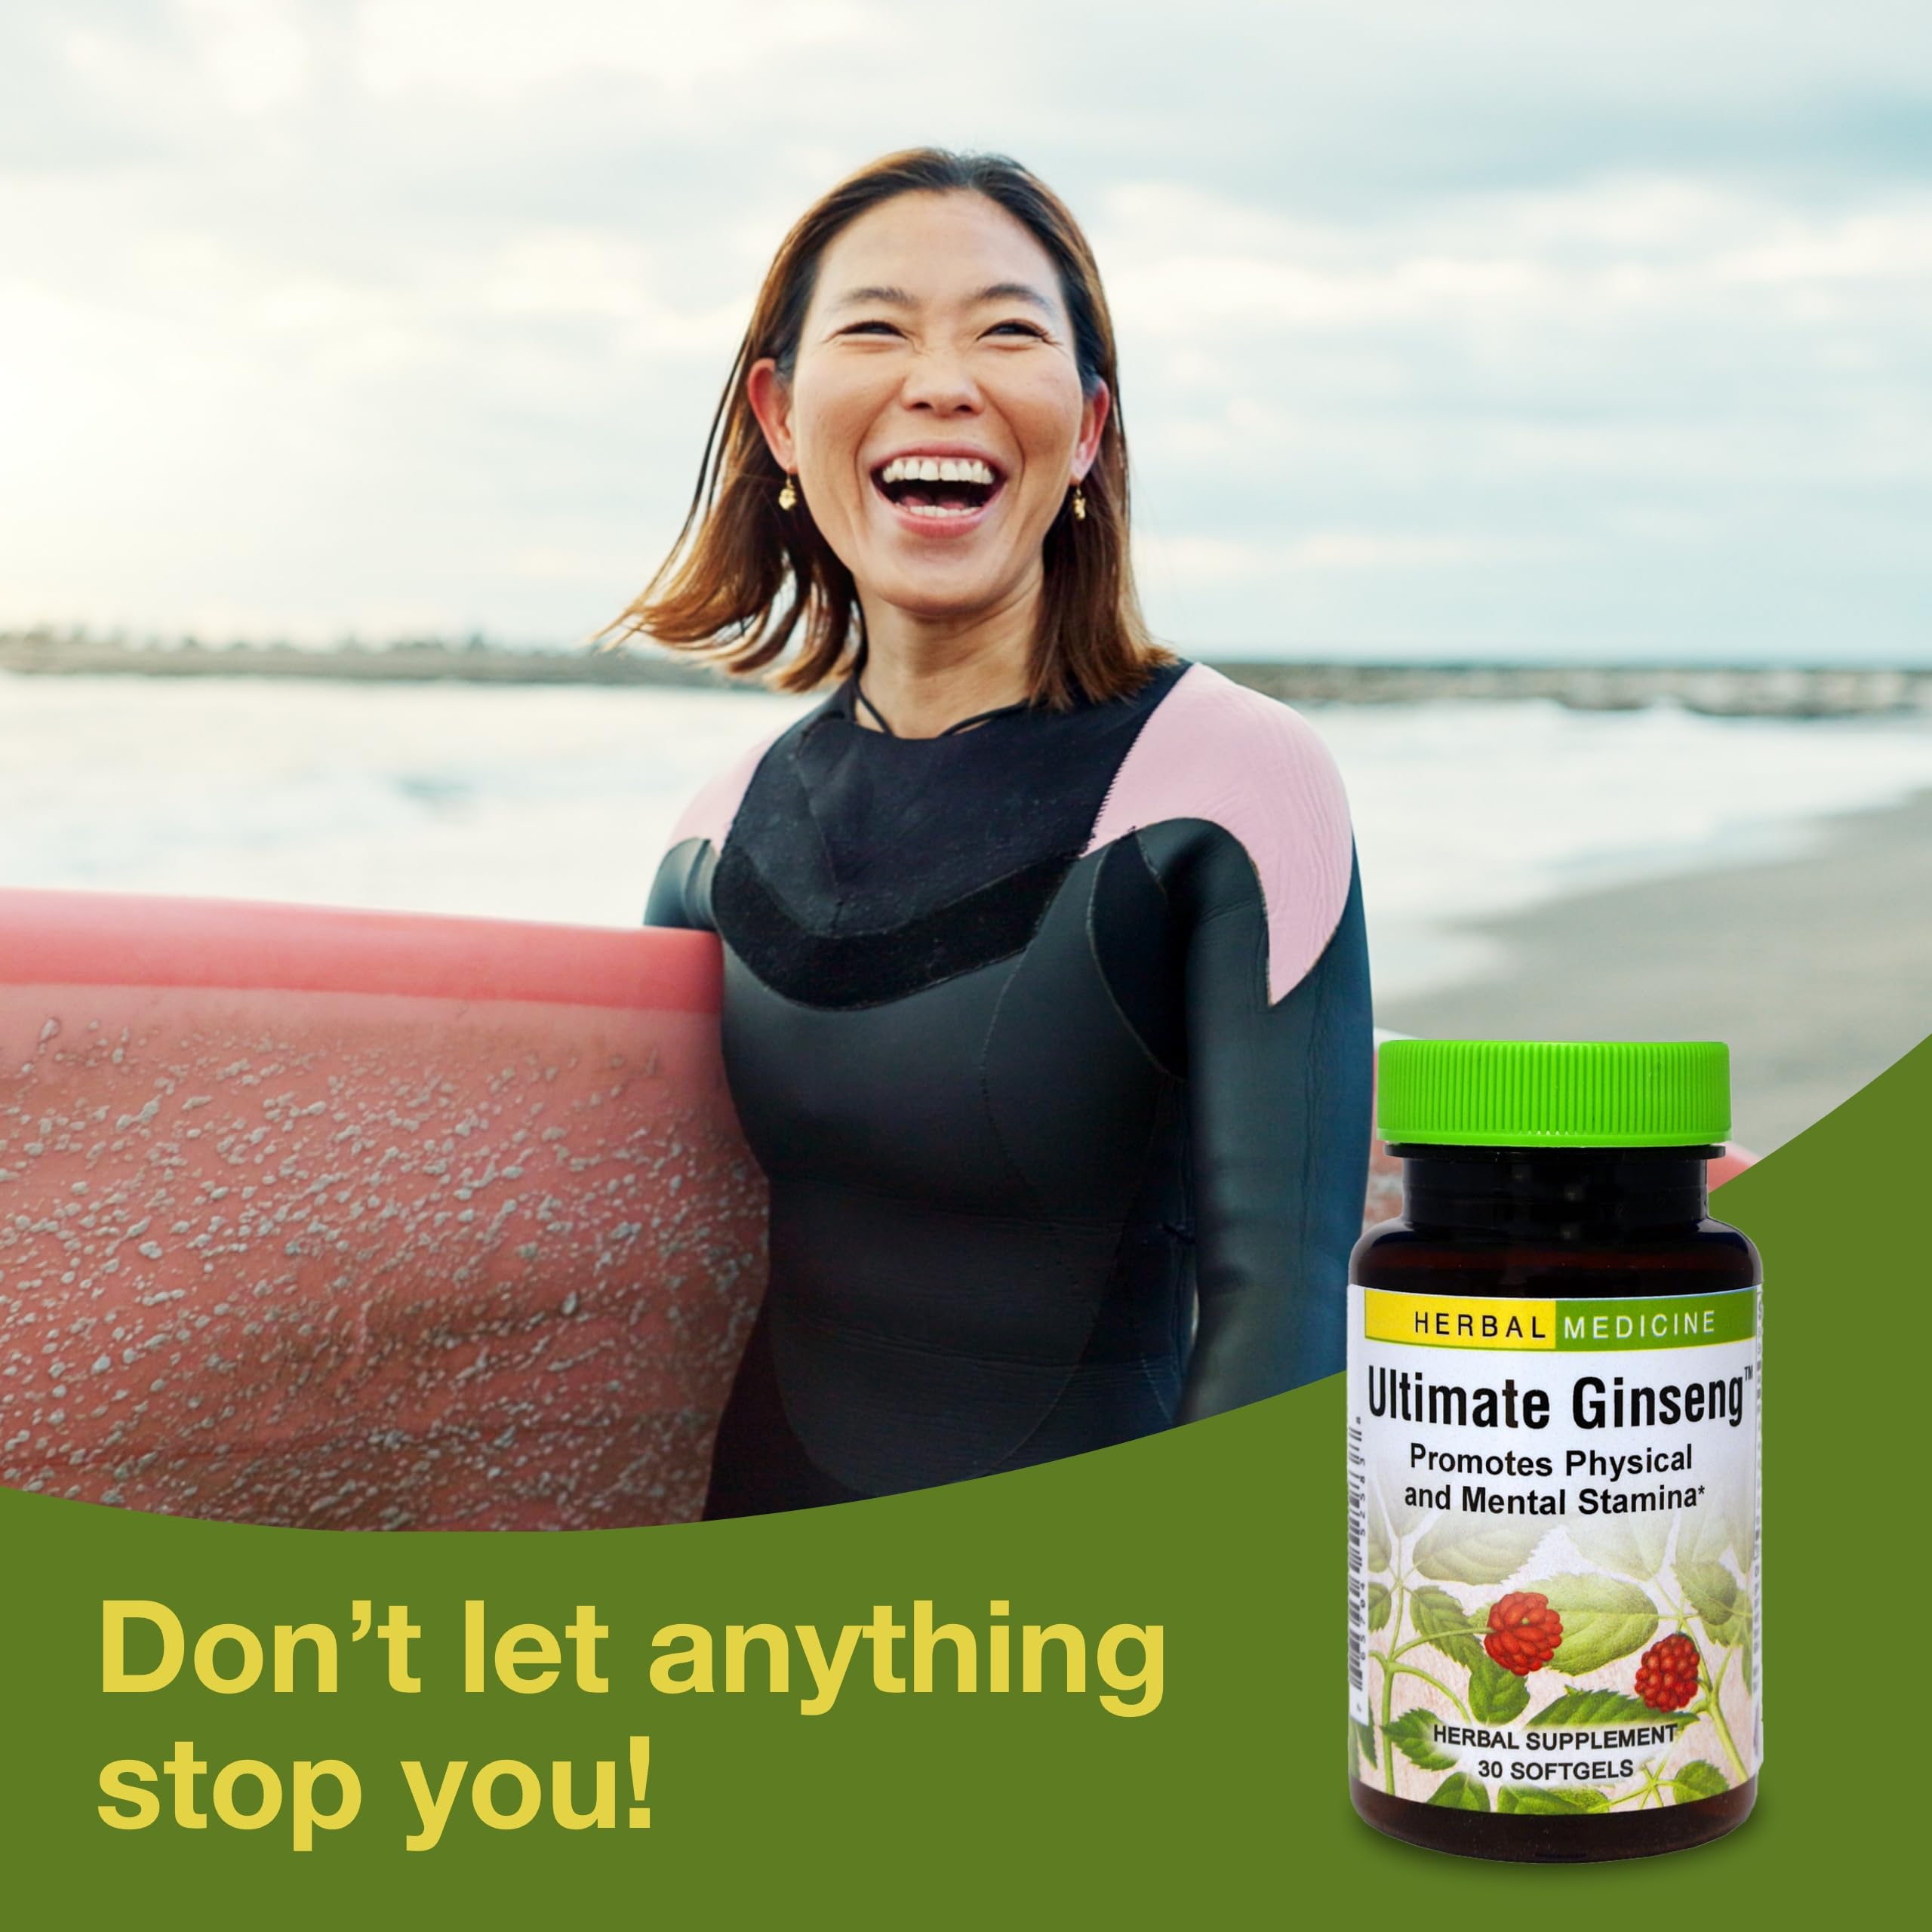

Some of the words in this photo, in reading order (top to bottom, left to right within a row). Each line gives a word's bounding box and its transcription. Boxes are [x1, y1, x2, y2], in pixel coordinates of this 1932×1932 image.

[1416, 1312, 1545, 1337] HERBAL
[1565, 1312, 1713, 1339] MEDICINE
[1369, 1366, 1549, 1429] Ultimate
[1411, 1443, 1552, 1476] Promotes
[1567, 1444, 1691, 1481] Physical
[1405, 1485, 1450, 1509] and
[1463, 1486, 1564, 1515] Mental
[1435, 1725, 1518, 1749] HERBAL
[1527, 1724, 1677, 1750] SUPPLEMENT
[1479, 1761, 1502, 1777] 30
[1512, 1760, 1632, 1780] SOFTGELS
